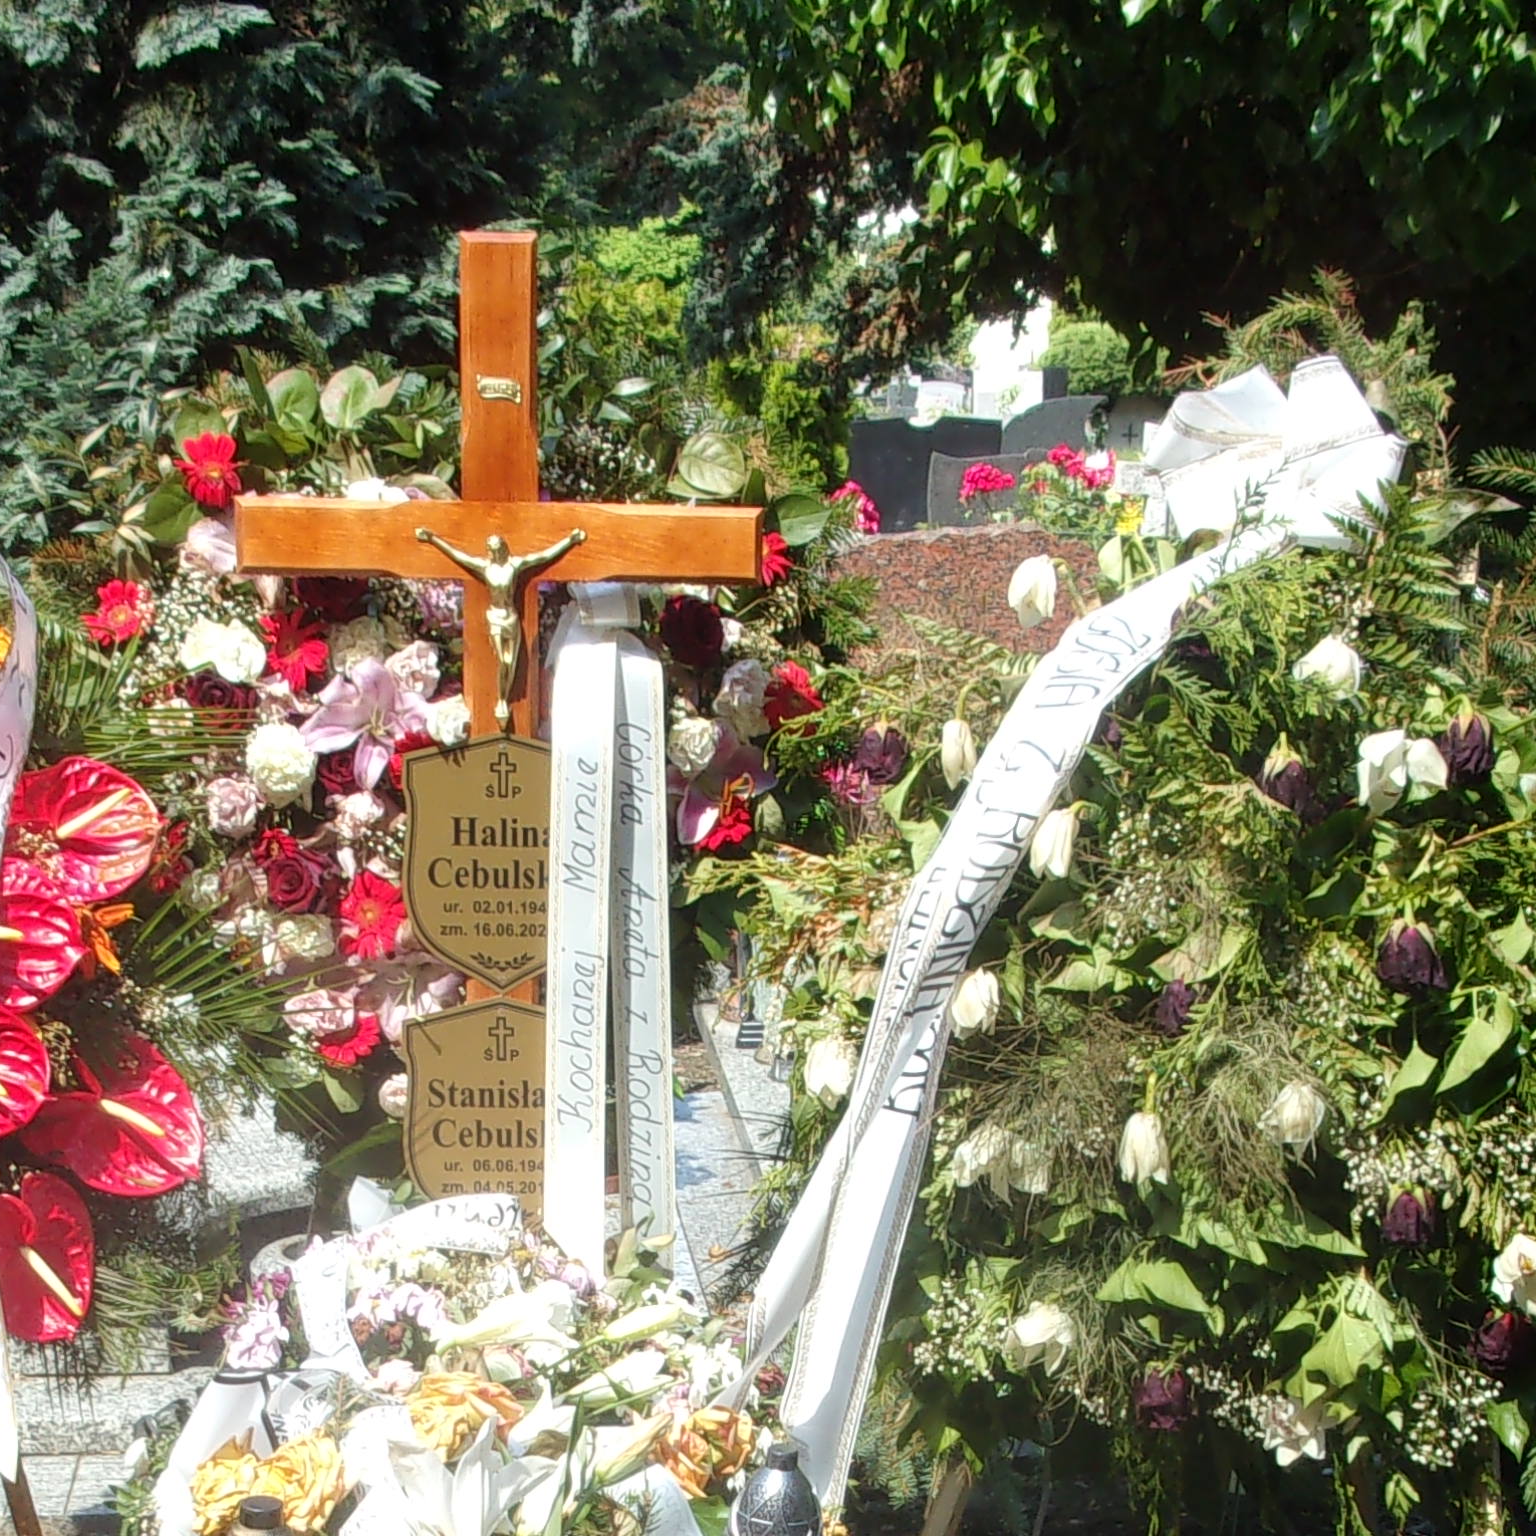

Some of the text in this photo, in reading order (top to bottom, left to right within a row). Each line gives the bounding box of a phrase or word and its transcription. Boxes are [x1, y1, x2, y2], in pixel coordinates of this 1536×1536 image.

[614, 721, 653, 826] Córka
[427, 856, 549, 889] Cebulsk
[442, 899, 547, 915] ur. 02.01.194
[439, 921, 547, 938] zm. 16.06.202
[556, 756, 605, 1133] Kochanej Mamie
[427, 1077, 545, 1109] Stanisła
[431, 1117, 545, 1148] Cebuls
[443, 1158, 544, 1173] ur. 06.06.194
[472, 1180, 544, 1195] 04.05.201
